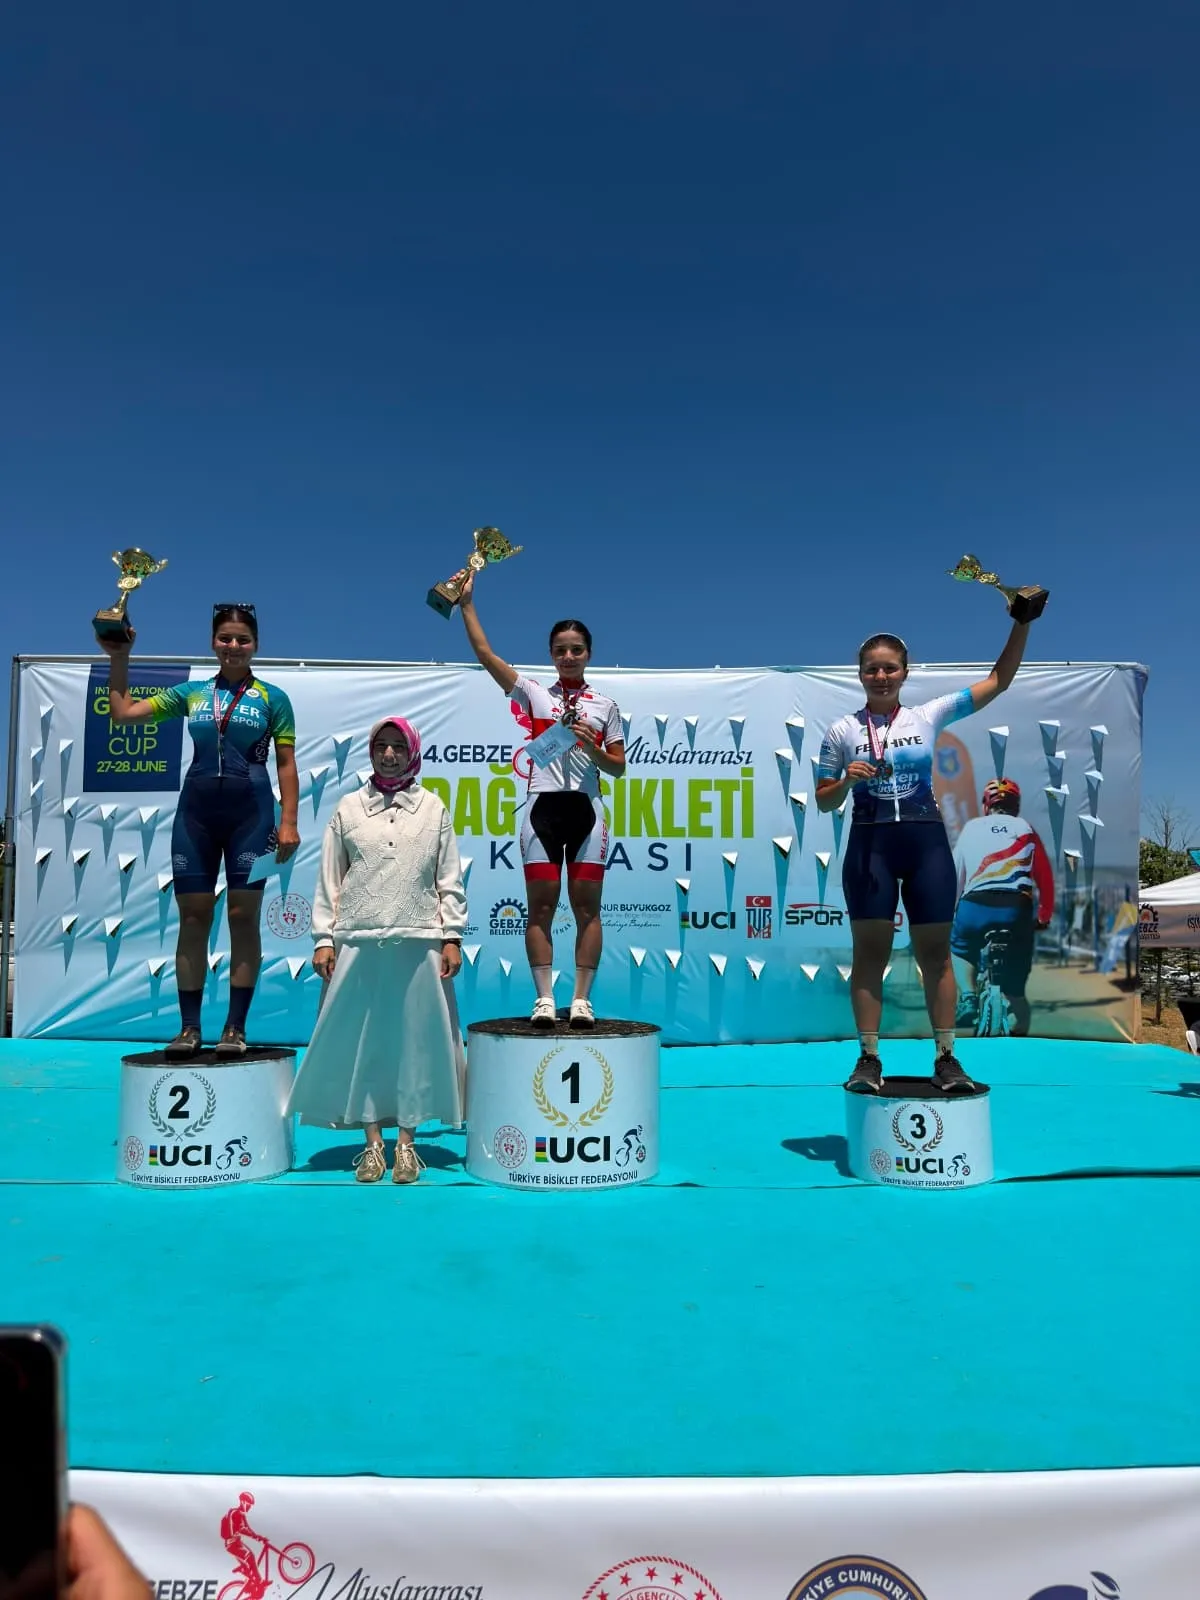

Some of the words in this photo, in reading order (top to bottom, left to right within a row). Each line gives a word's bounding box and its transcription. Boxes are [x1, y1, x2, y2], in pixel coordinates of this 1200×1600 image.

[108, 737, 157, 755] CUP
[422, 744, 513, 763] 4.GEBZE
[96, 760, 130, 773] 27-28
[132, 760, 167, 773] JUNE
[421, 763, 517, 837] DAĞ
[991, 825, 1008, 834] 64
[489, 918, 528, 929] GEBZE
[691, 911, 736, 930] UCI
[1139, 922, 1159, 933] EBZE
[561, 1062, 580, 1104] 1
[167, 1085, 190, 1119] 2
[910, 1113, 927, 1139] 3
[159, 1145, 212, 1167] UCI
[550, 1136, 611, 1163] UCI
[905, 1157, 944, 1174] UCI
[154, 1174, 182, 1185] BİSİKLET
[184, 1172, 241, 1184] FEDERASYONU
[508, 1172, 541, 1184] TÜRKİYE
[543, 1173, 579, 1185] BİSİKLET
[581, 1170, 638, 1185] FEDERASYONU
[148, 1580, 218, 1600] EBZE
[802, 1575, 836, 1600] KİYE
[838, 1569, 911, 1600] CUMHURİ
